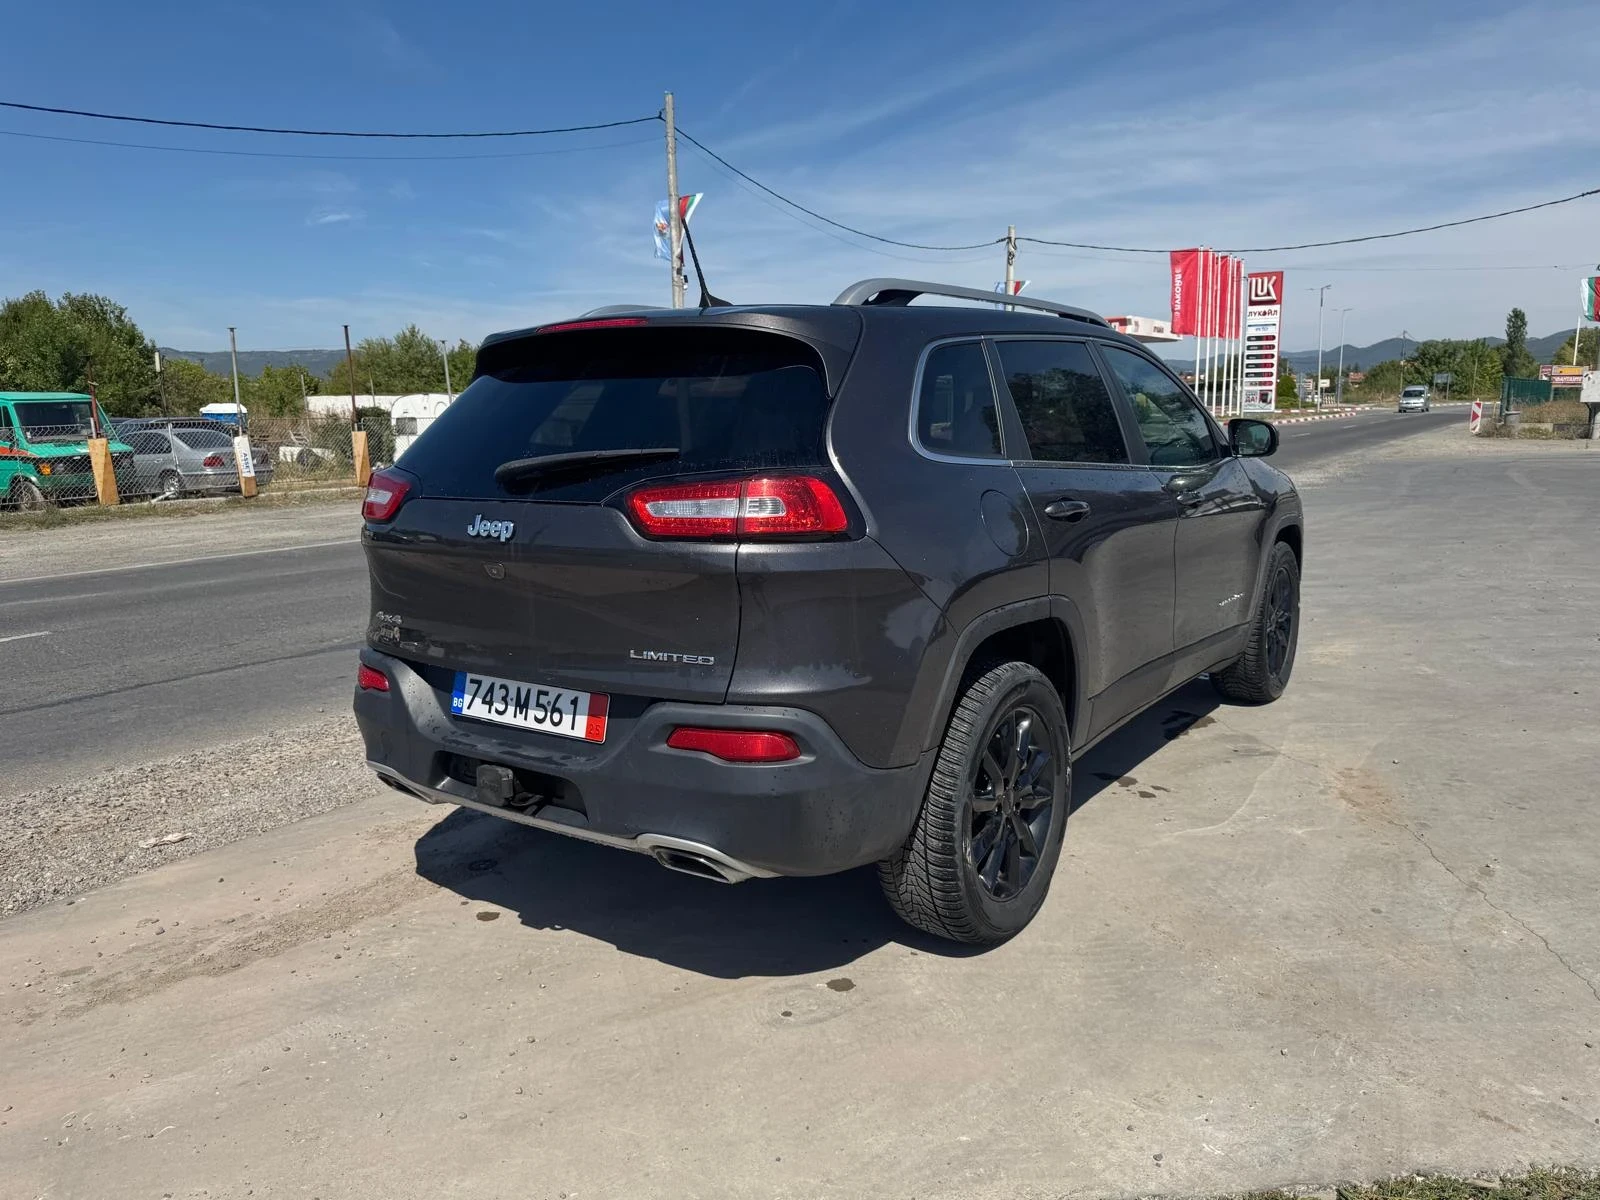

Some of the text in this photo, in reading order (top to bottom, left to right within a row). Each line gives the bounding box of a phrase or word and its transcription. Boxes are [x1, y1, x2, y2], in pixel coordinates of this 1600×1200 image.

[1247, 309, 1278, 317] ЛУКОЙЛ
[467, 514, 514, 542] Jeep
[629, 649, 715, 666] LIMITED
[453, 697, 463, 708] BG
[589, 724, 600, 735] 25
